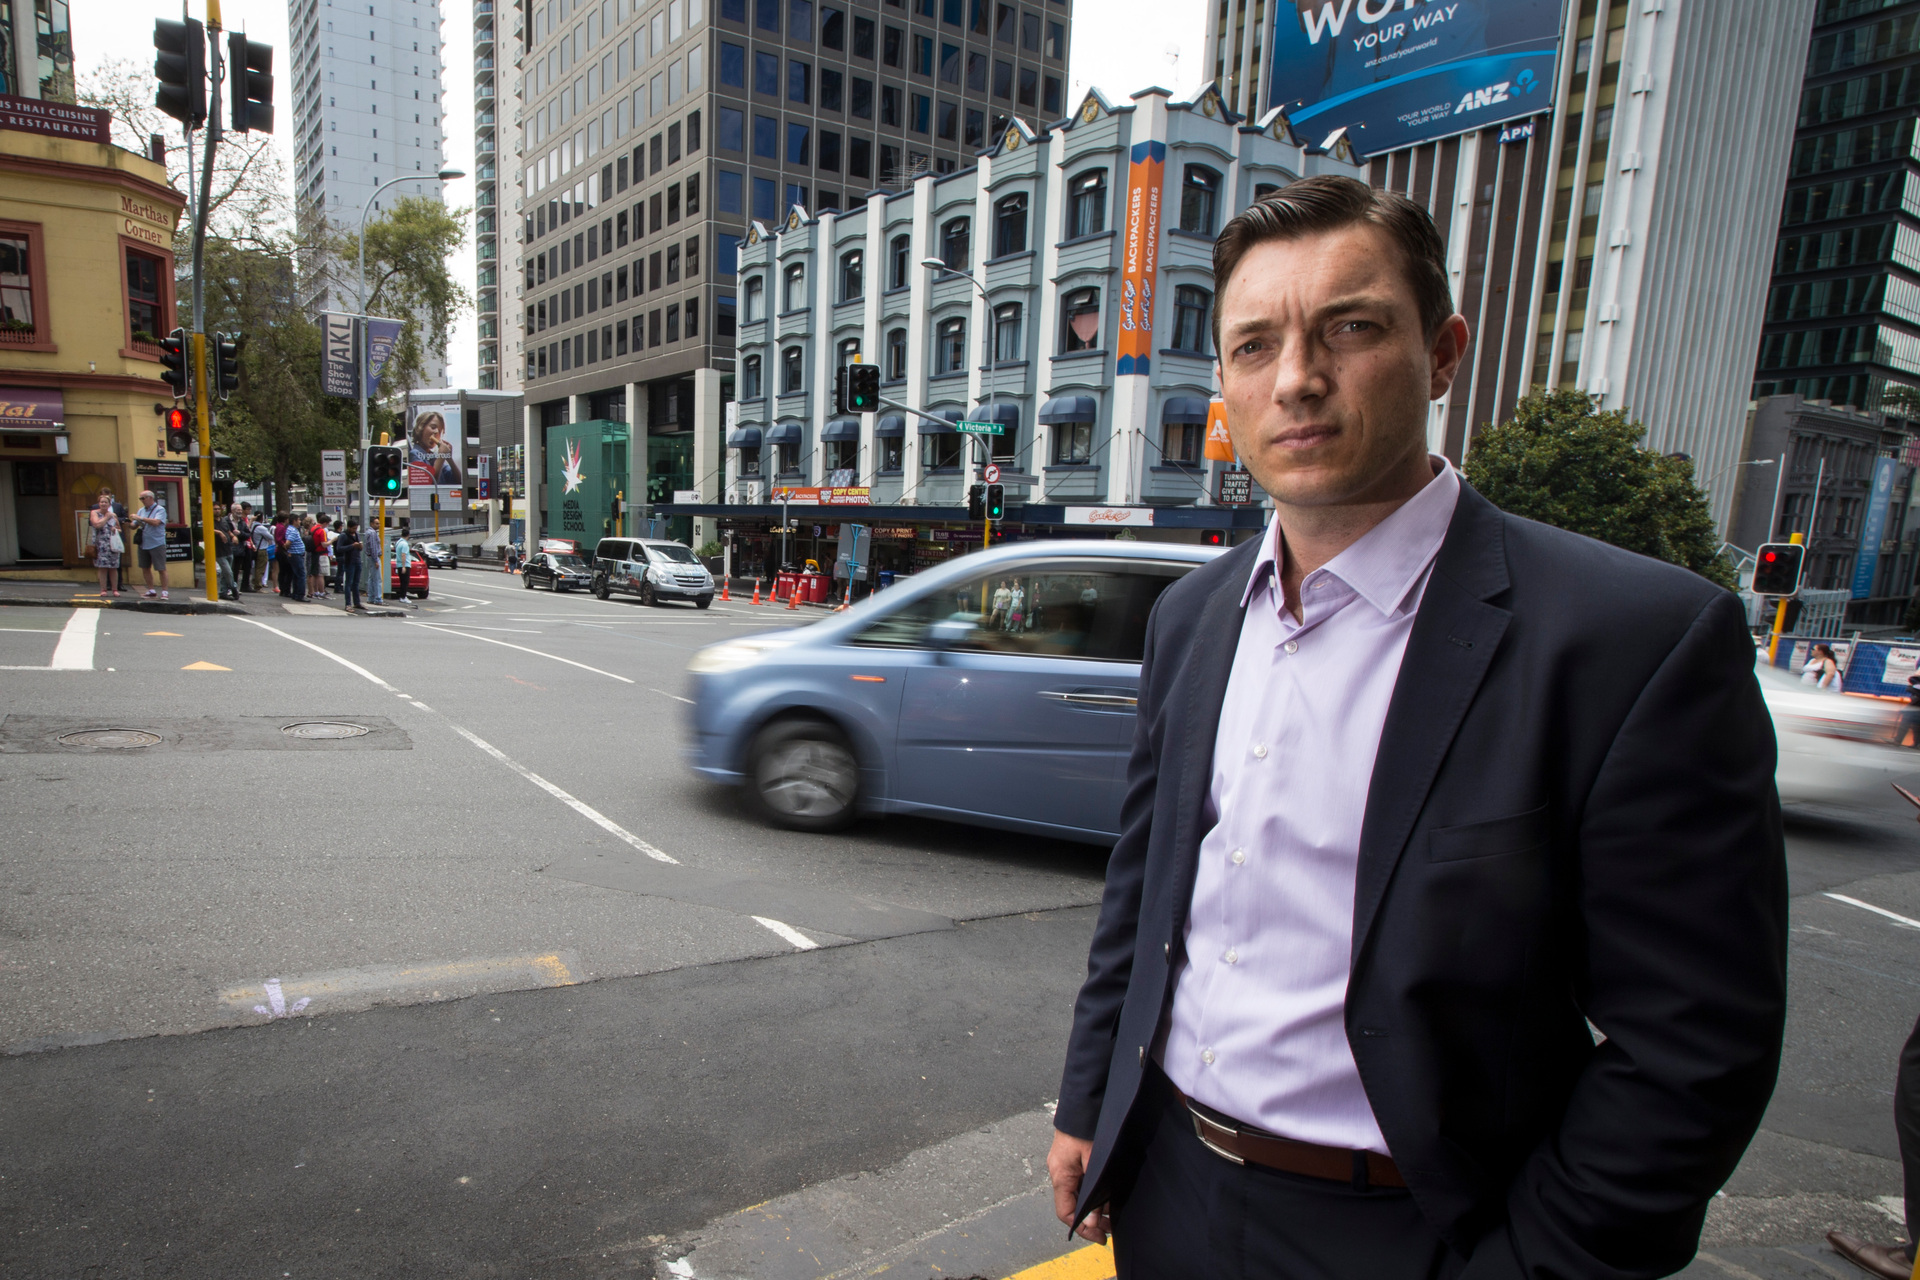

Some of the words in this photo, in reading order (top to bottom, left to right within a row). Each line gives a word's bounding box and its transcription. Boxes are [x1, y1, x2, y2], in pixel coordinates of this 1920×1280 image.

[1353, 23, 1405, 52] YOUR
[1412, 3, 1458, 32] WAY
[1364, 37, 1438, 68] anz.co.nz/yourworld
[1454, 81, 1510, 114] ANZ
[16, 102, 44, 114] THAI
[49, 108, 96, 122] CUISINE
[1397, 111, 1420, 122] YOUR
[1420, 102, 1451, 116] WORLD
[1407, 115, 1430, 127] YOUR
[1430, 110, 1450, 120] WAY
[10, 116, 97, 136] RESTAURANT
[1500, 124, 1534, 142] APN
[121, 195, 168, 225] Marthas
[125, 218, 162, 244] Corner
[1128, 186, 1142, 273] BACKPACKERS
[1146, 186, 1158, 272] BACKPACKERS
[330, 318, 351, 362] AKL
[328, 362, 344, 370] The
[328, 378, 353, 388] Never
[328, 385, 353, 395] Stops
[964, 422, 992, 432] Victoria
[426, 452, 452, 461] generous
[189, 470, 231, 479] FLIST
[563, 500, 580, 510] MEDIA
[563, 511, 582, 520] DESIGN
[563, 522, 586, 532] SCHOOL
